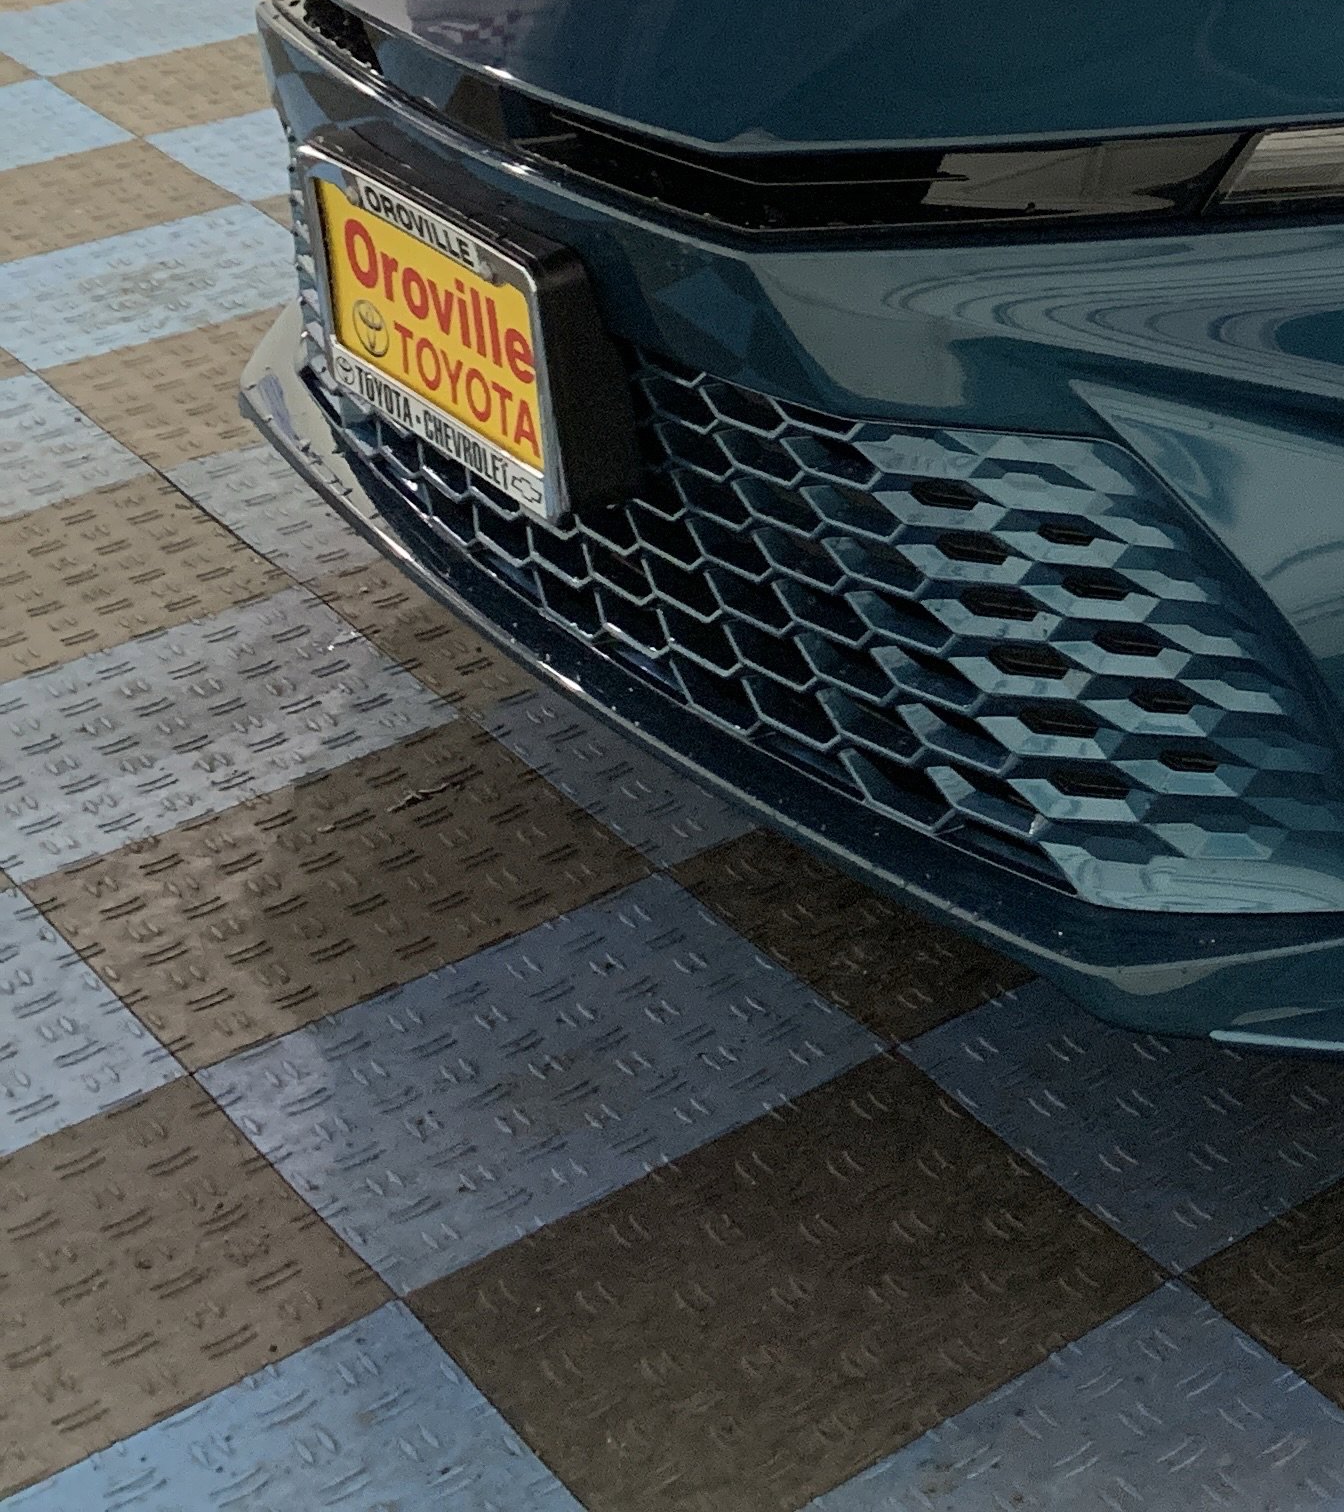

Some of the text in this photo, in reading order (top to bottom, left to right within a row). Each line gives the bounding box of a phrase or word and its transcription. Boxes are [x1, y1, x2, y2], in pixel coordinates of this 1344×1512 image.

[364, 185, 472, 266] OROVILLE
[344, 218, 536, 385] Oroville
[355, 364, 510, 491] TOYOTA CHEVROLET
[394, 319, 541, 460] TOYOTA
